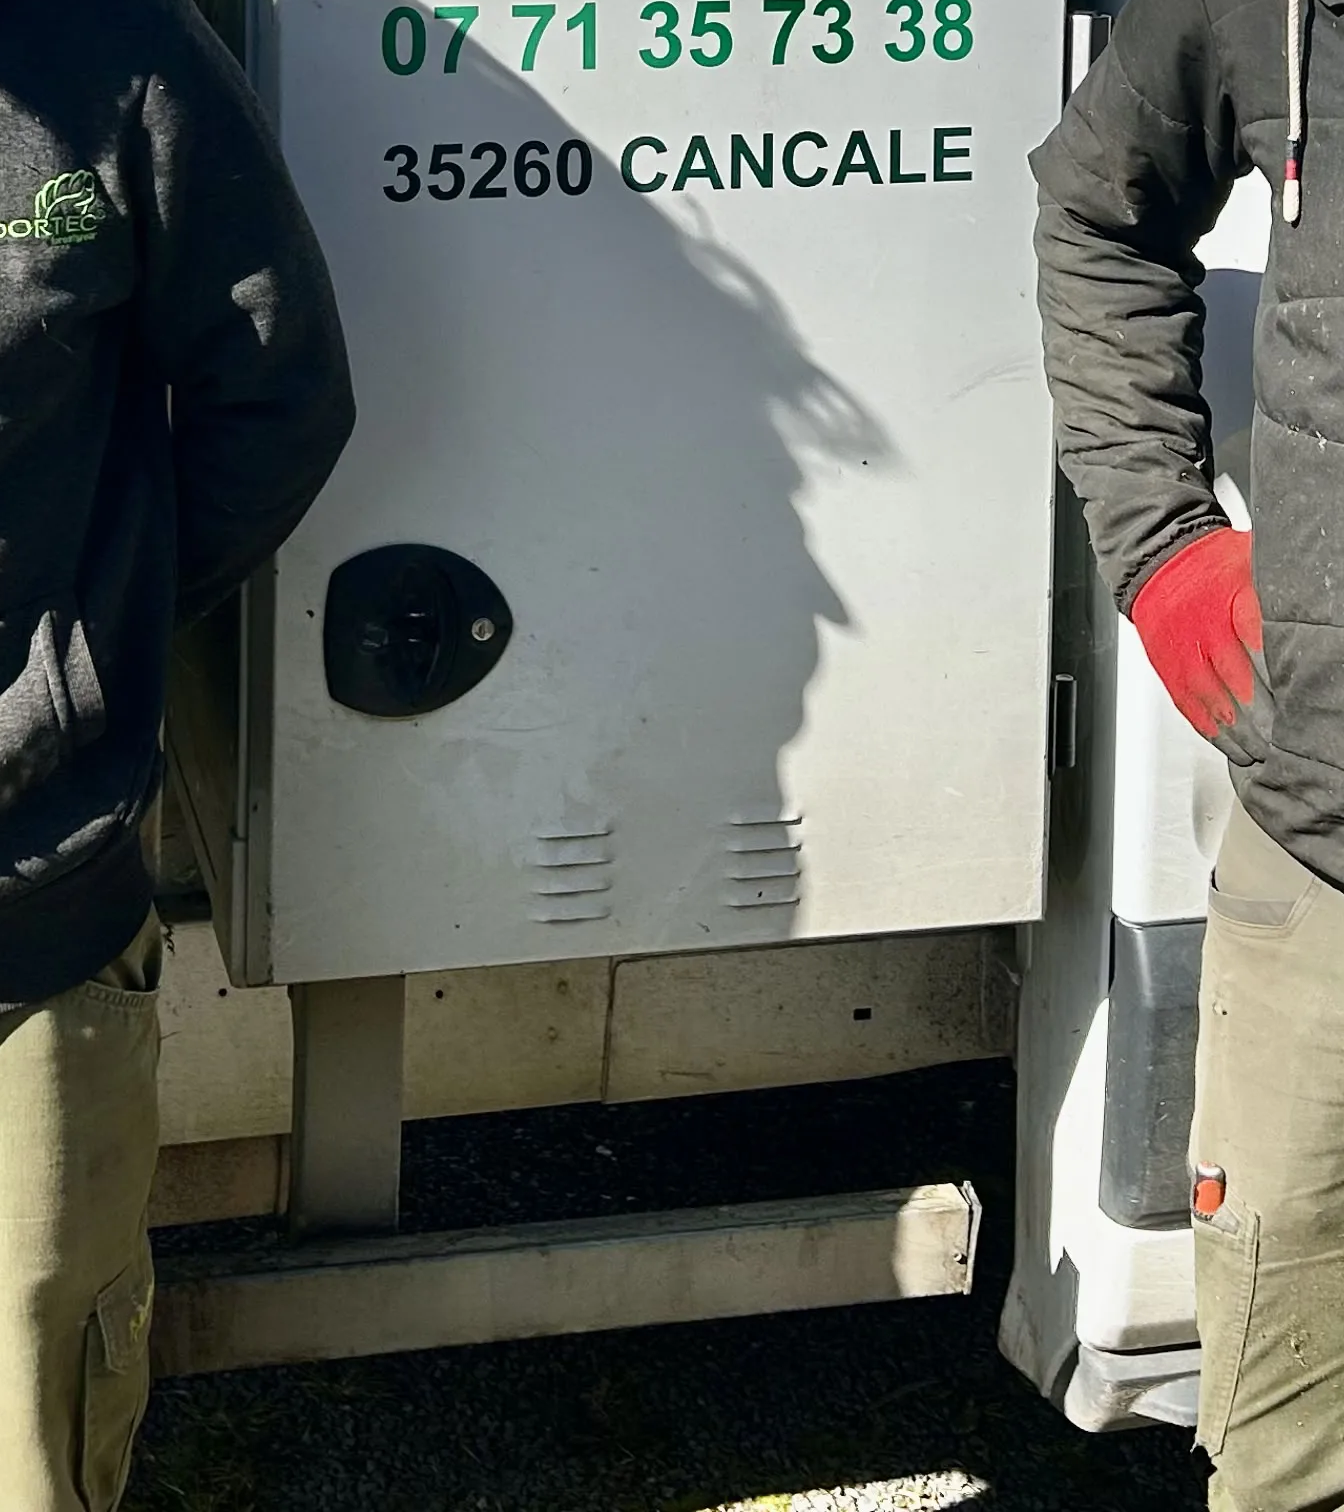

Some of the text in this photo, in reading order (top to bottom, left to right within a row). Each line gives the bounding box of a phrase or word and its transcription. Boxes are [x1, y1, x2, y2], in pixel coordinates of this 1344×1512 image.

[380, 6, 480, 77] 07
[511, 2, 598, 72] 71
[638, 0, 734, 68] 35
[382, 127, 974, 204] 35260 CANCALE
